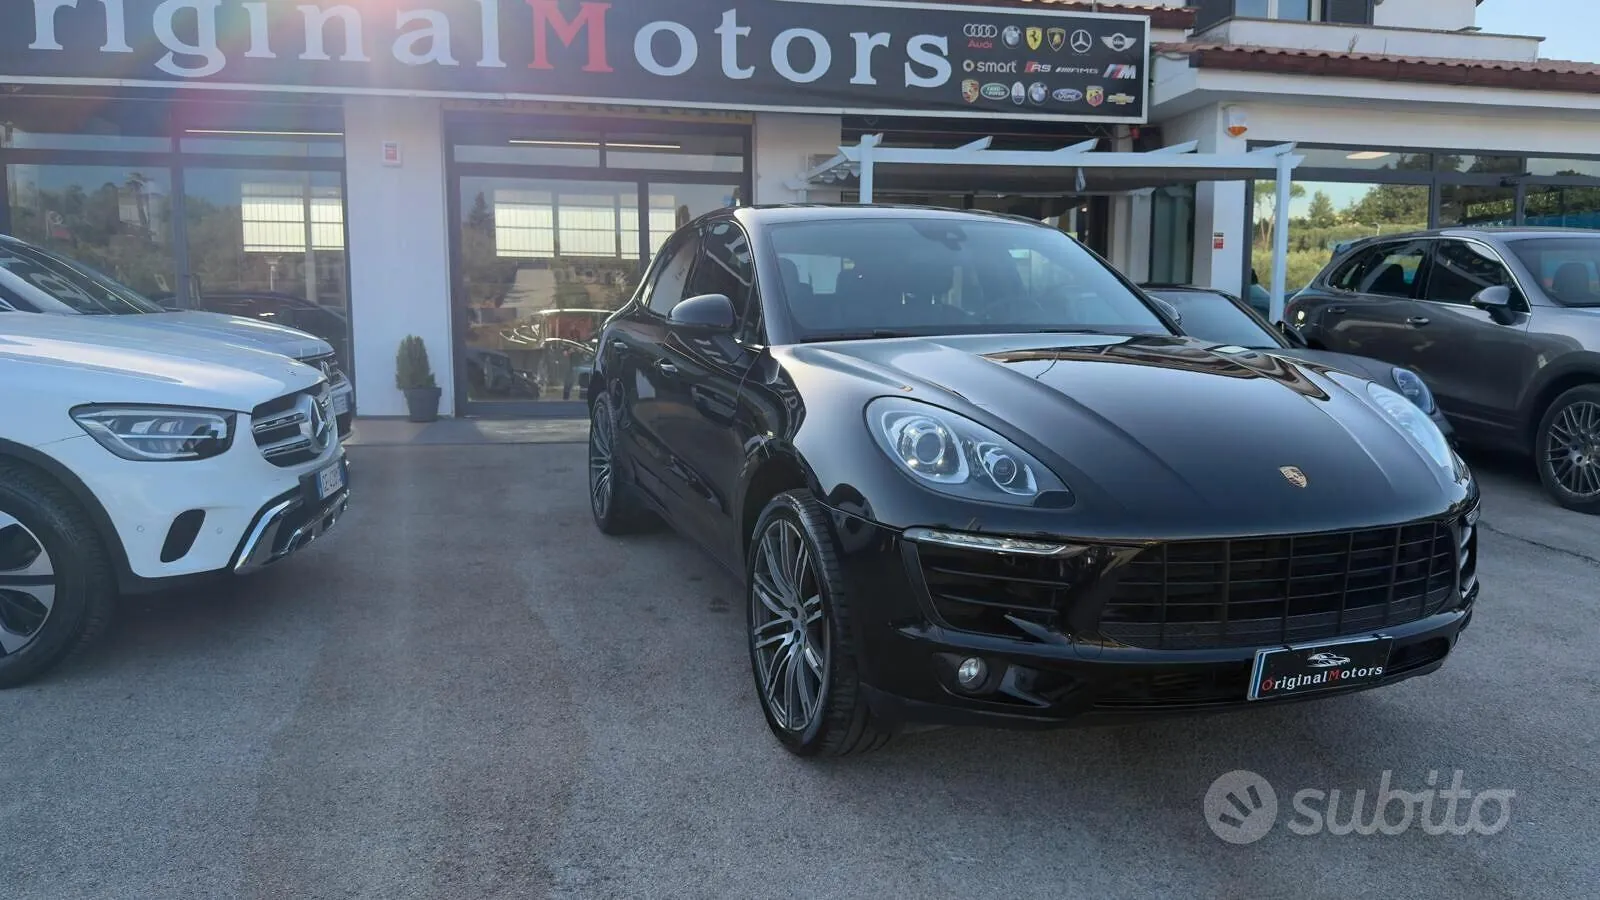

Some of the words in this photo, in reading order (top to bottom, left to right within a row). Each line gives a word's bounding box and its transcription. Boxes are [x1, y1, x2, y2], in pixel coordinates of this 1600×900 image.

[967, 40, 993, 49] Audi
[976, 61, 1017, 73] smart
[1030, 64, 1052, 73] RS
[1261, 665, 1384, 692] OriginalMotors
